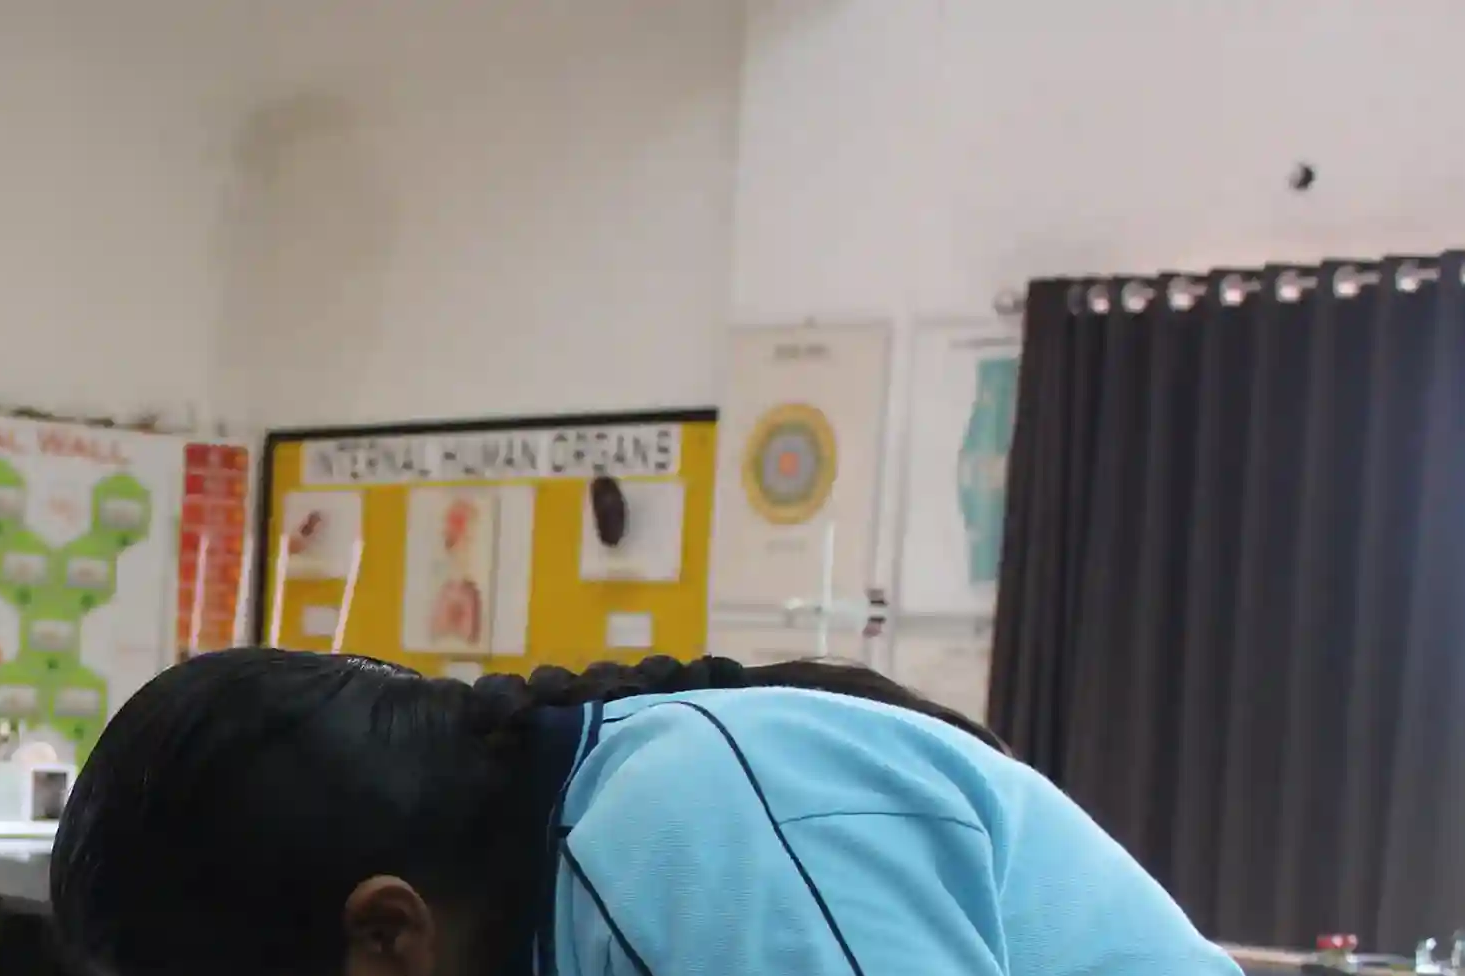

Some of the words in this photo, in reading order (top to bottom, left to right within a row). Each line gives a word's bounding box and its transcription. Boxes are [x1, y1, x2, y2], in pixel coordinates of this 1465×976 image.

[37, 424, 129, 465] WALL
[307, 438, 431, 480] INTERNAL
[443, 433, 537, 475] HUMAN
[549, 428, 672, 476] ORGANS
